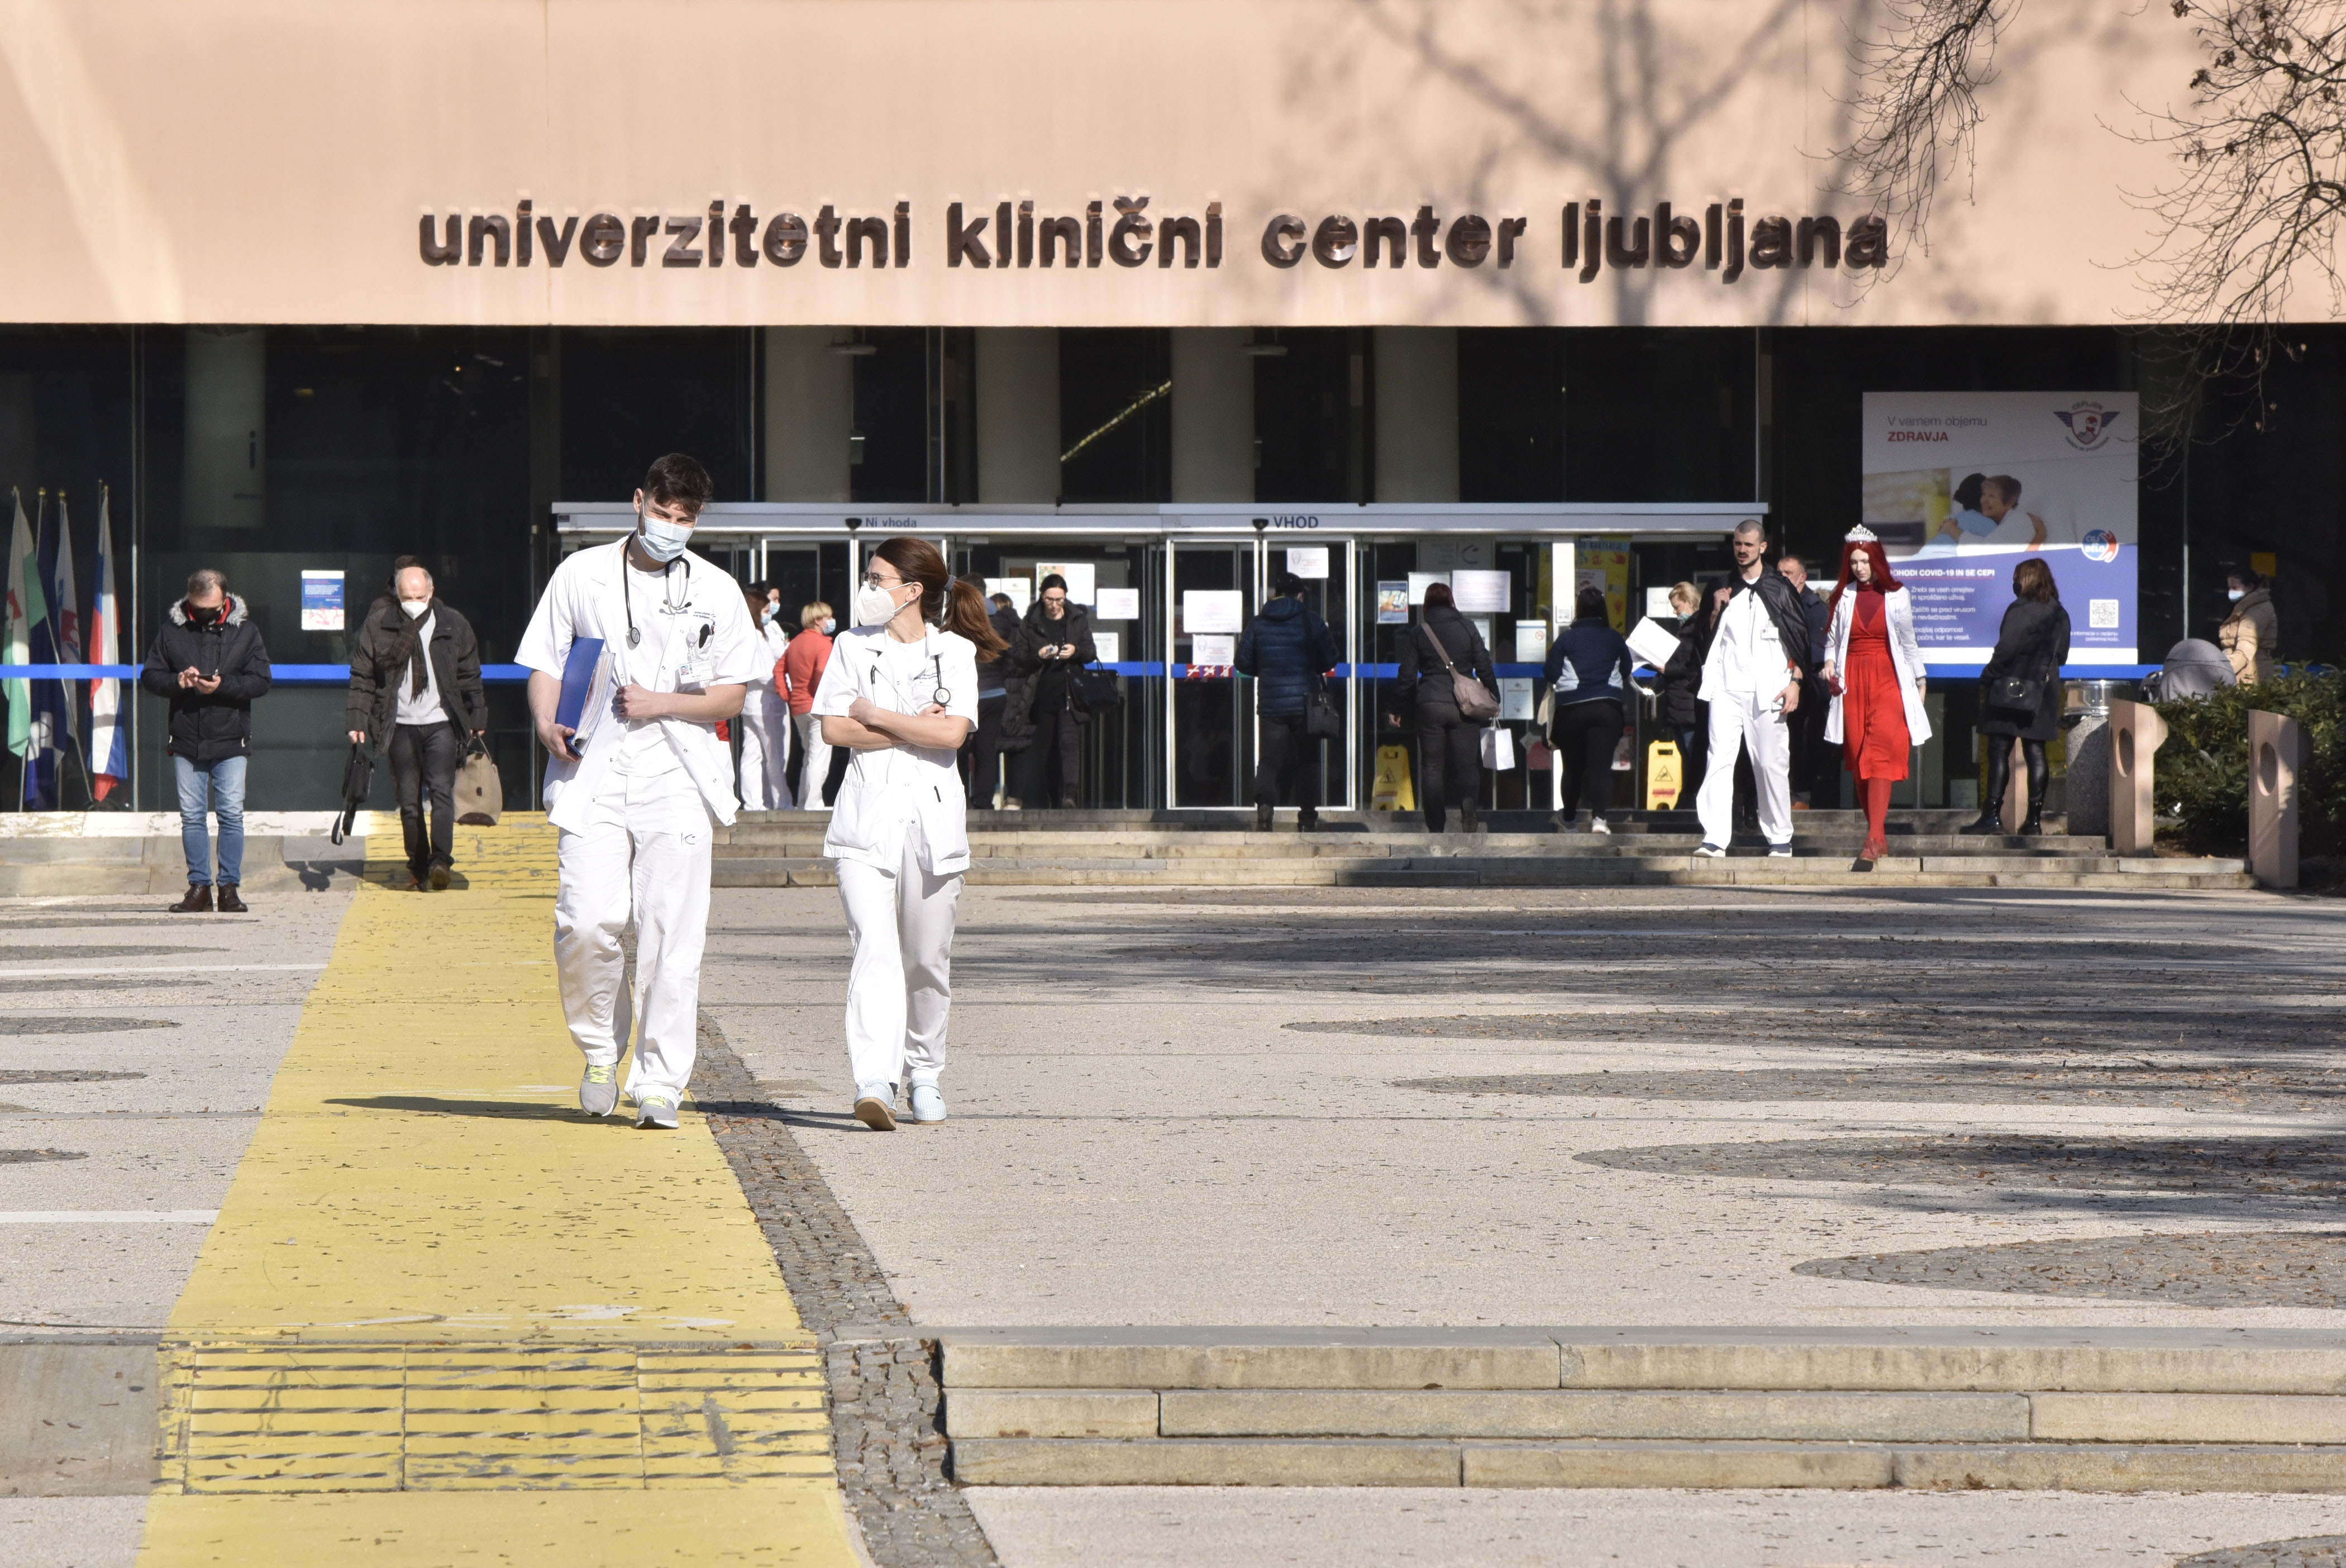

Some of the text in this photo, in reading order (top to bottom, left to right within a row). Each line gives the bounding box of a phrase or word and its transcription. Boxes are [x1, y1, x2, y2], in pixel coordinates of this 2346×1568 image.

[419, 196, 1889, 284] univerzitetni klinični center ljubljana
[1887, 416, 1987, 428] V varnem objemu
[1887, 431, 1948, 442] ZDRAVJA
[866, 517, 917, 527] Ni vhoda
[1274, 516, 1319, 528] VHOD
